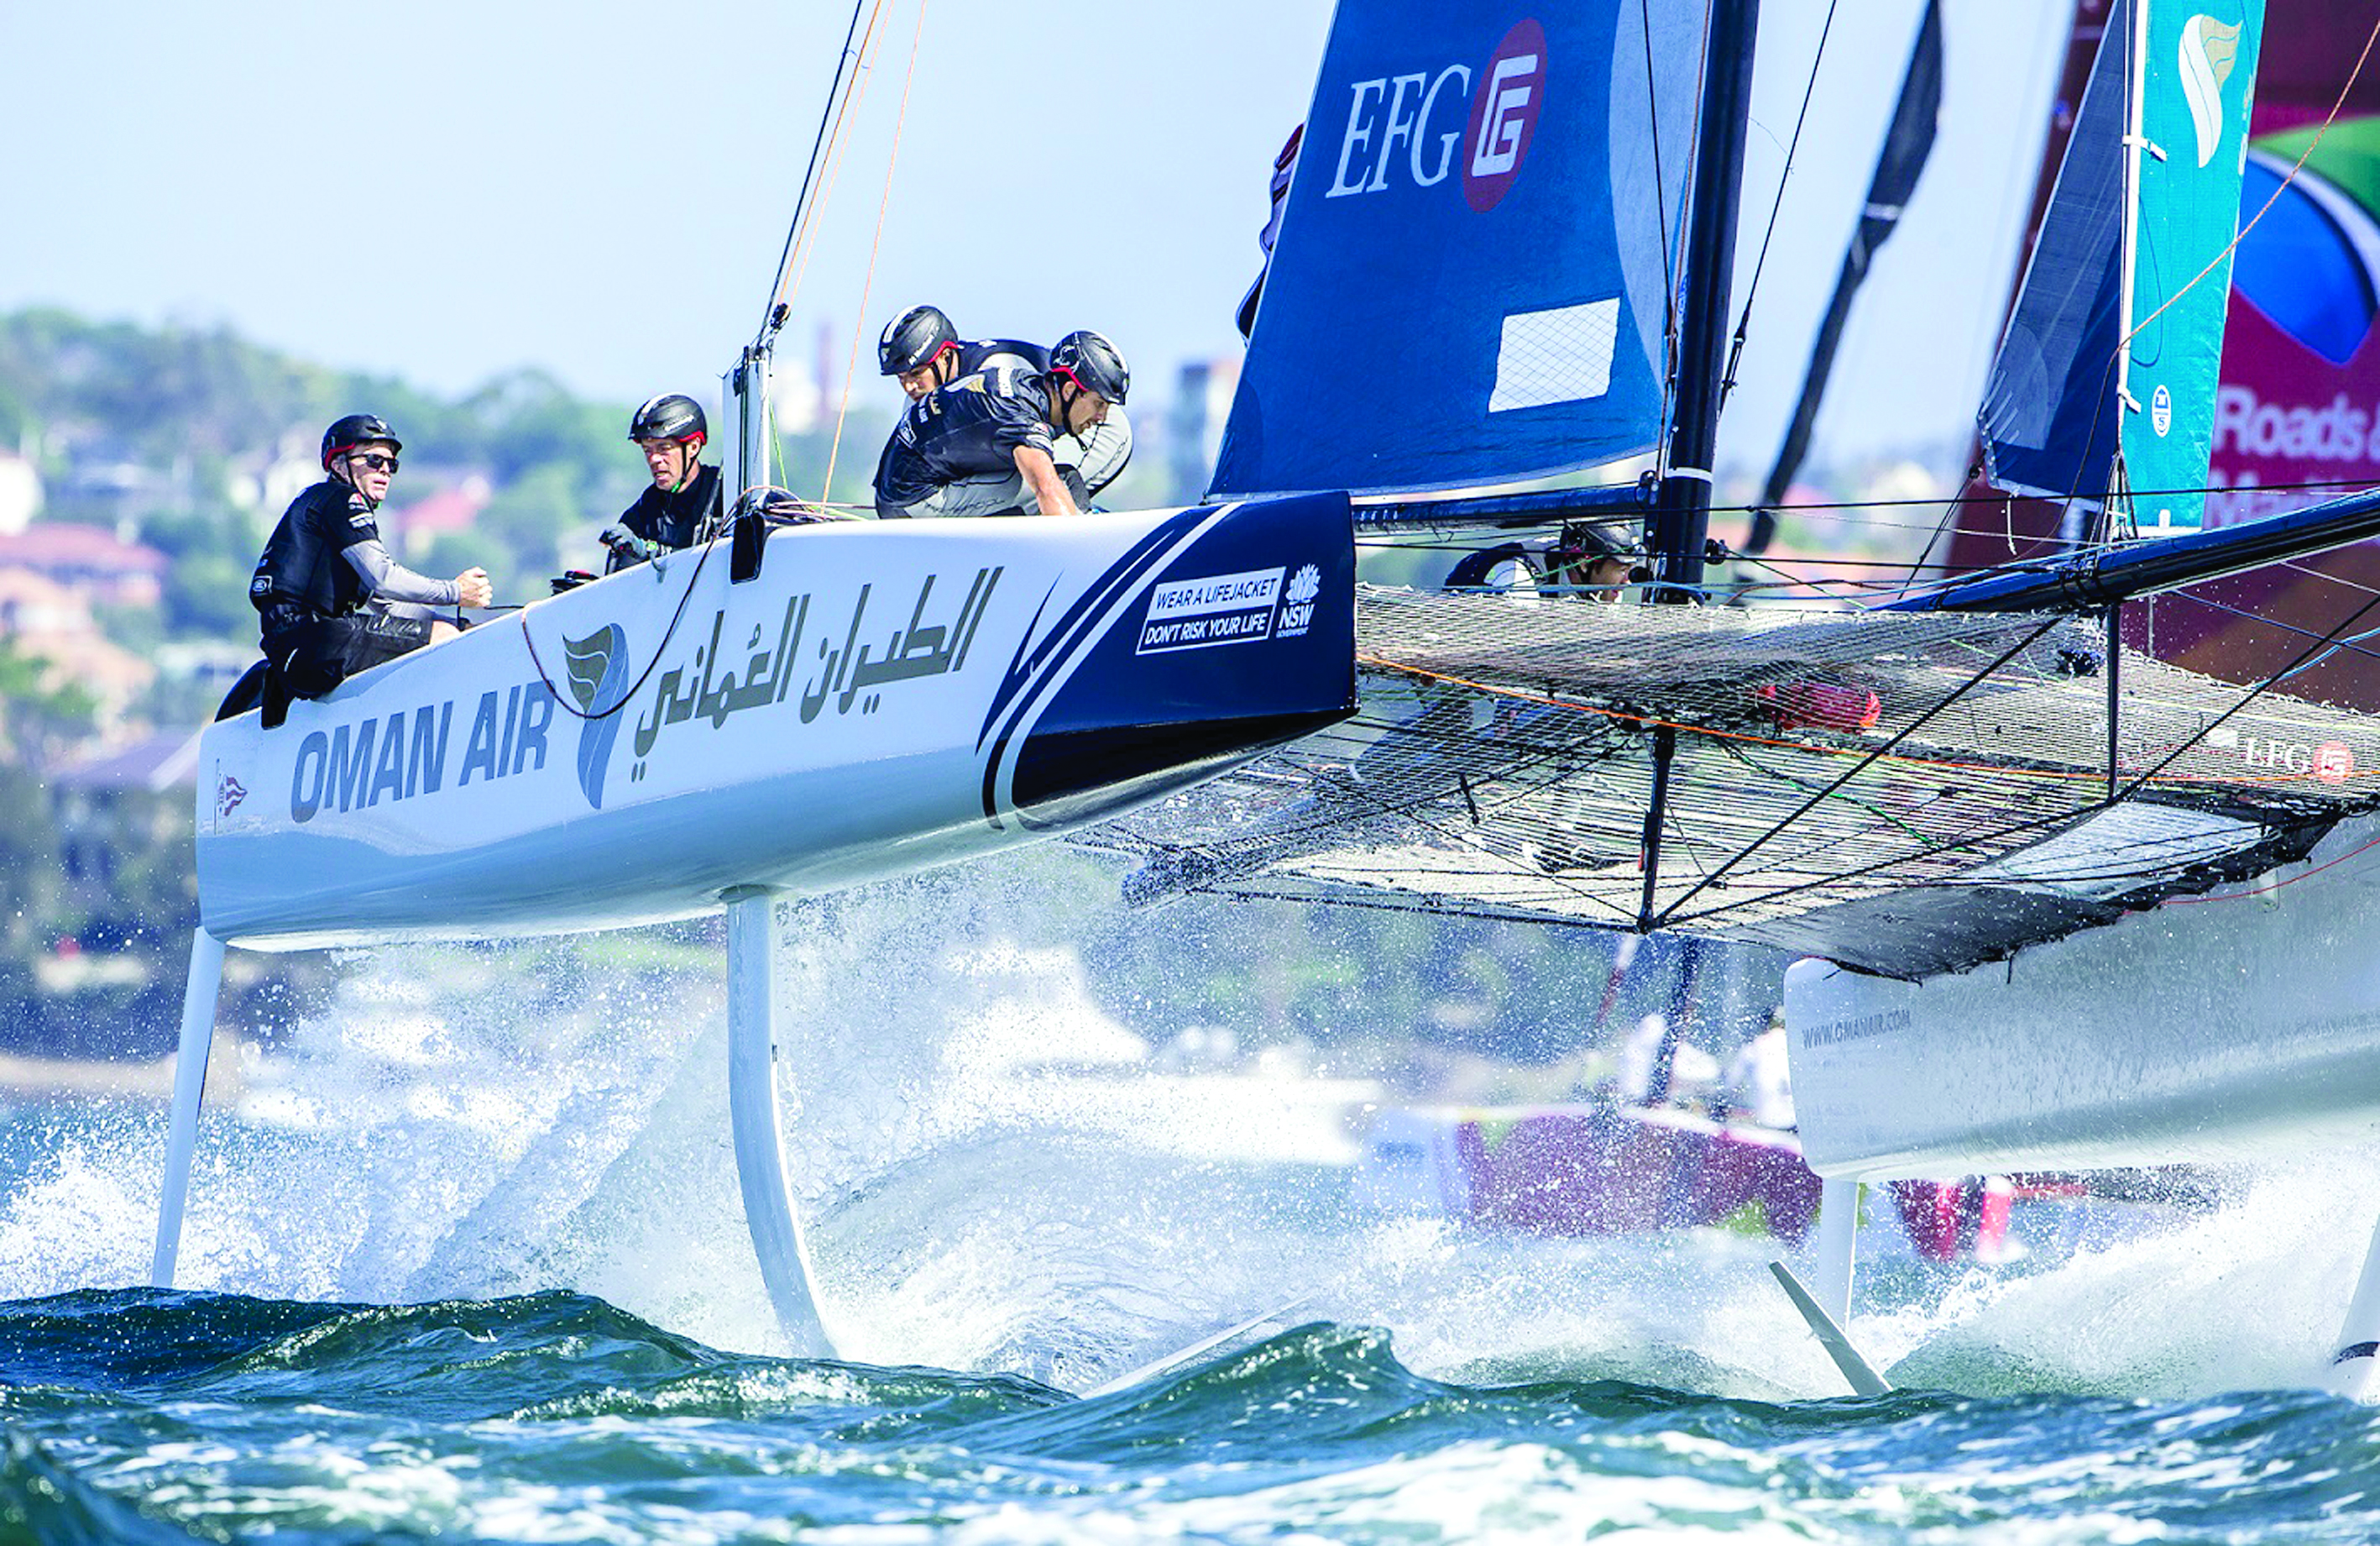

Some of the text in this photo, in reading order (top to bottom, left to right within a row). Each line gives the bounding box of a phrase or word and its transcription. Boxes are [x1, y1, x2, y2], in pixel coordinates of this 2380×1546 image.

[1326, 64, 1471, 198] EFG
[2211, 384, 2367, 462] Roads
[1156, 578, 1278, 610] WEAR A LIFEJACKET
[1144, 612, 1268, 645] DON'T RISK YOUR LIFE
[1279, 604, 1315, 629] NSW
[290, 679, 556, 823] OMAN AIR
[2246, 737, 2313, 773] EFG
[1802, 1009, 1912, 1050] WWW.OMANAIR.COM
